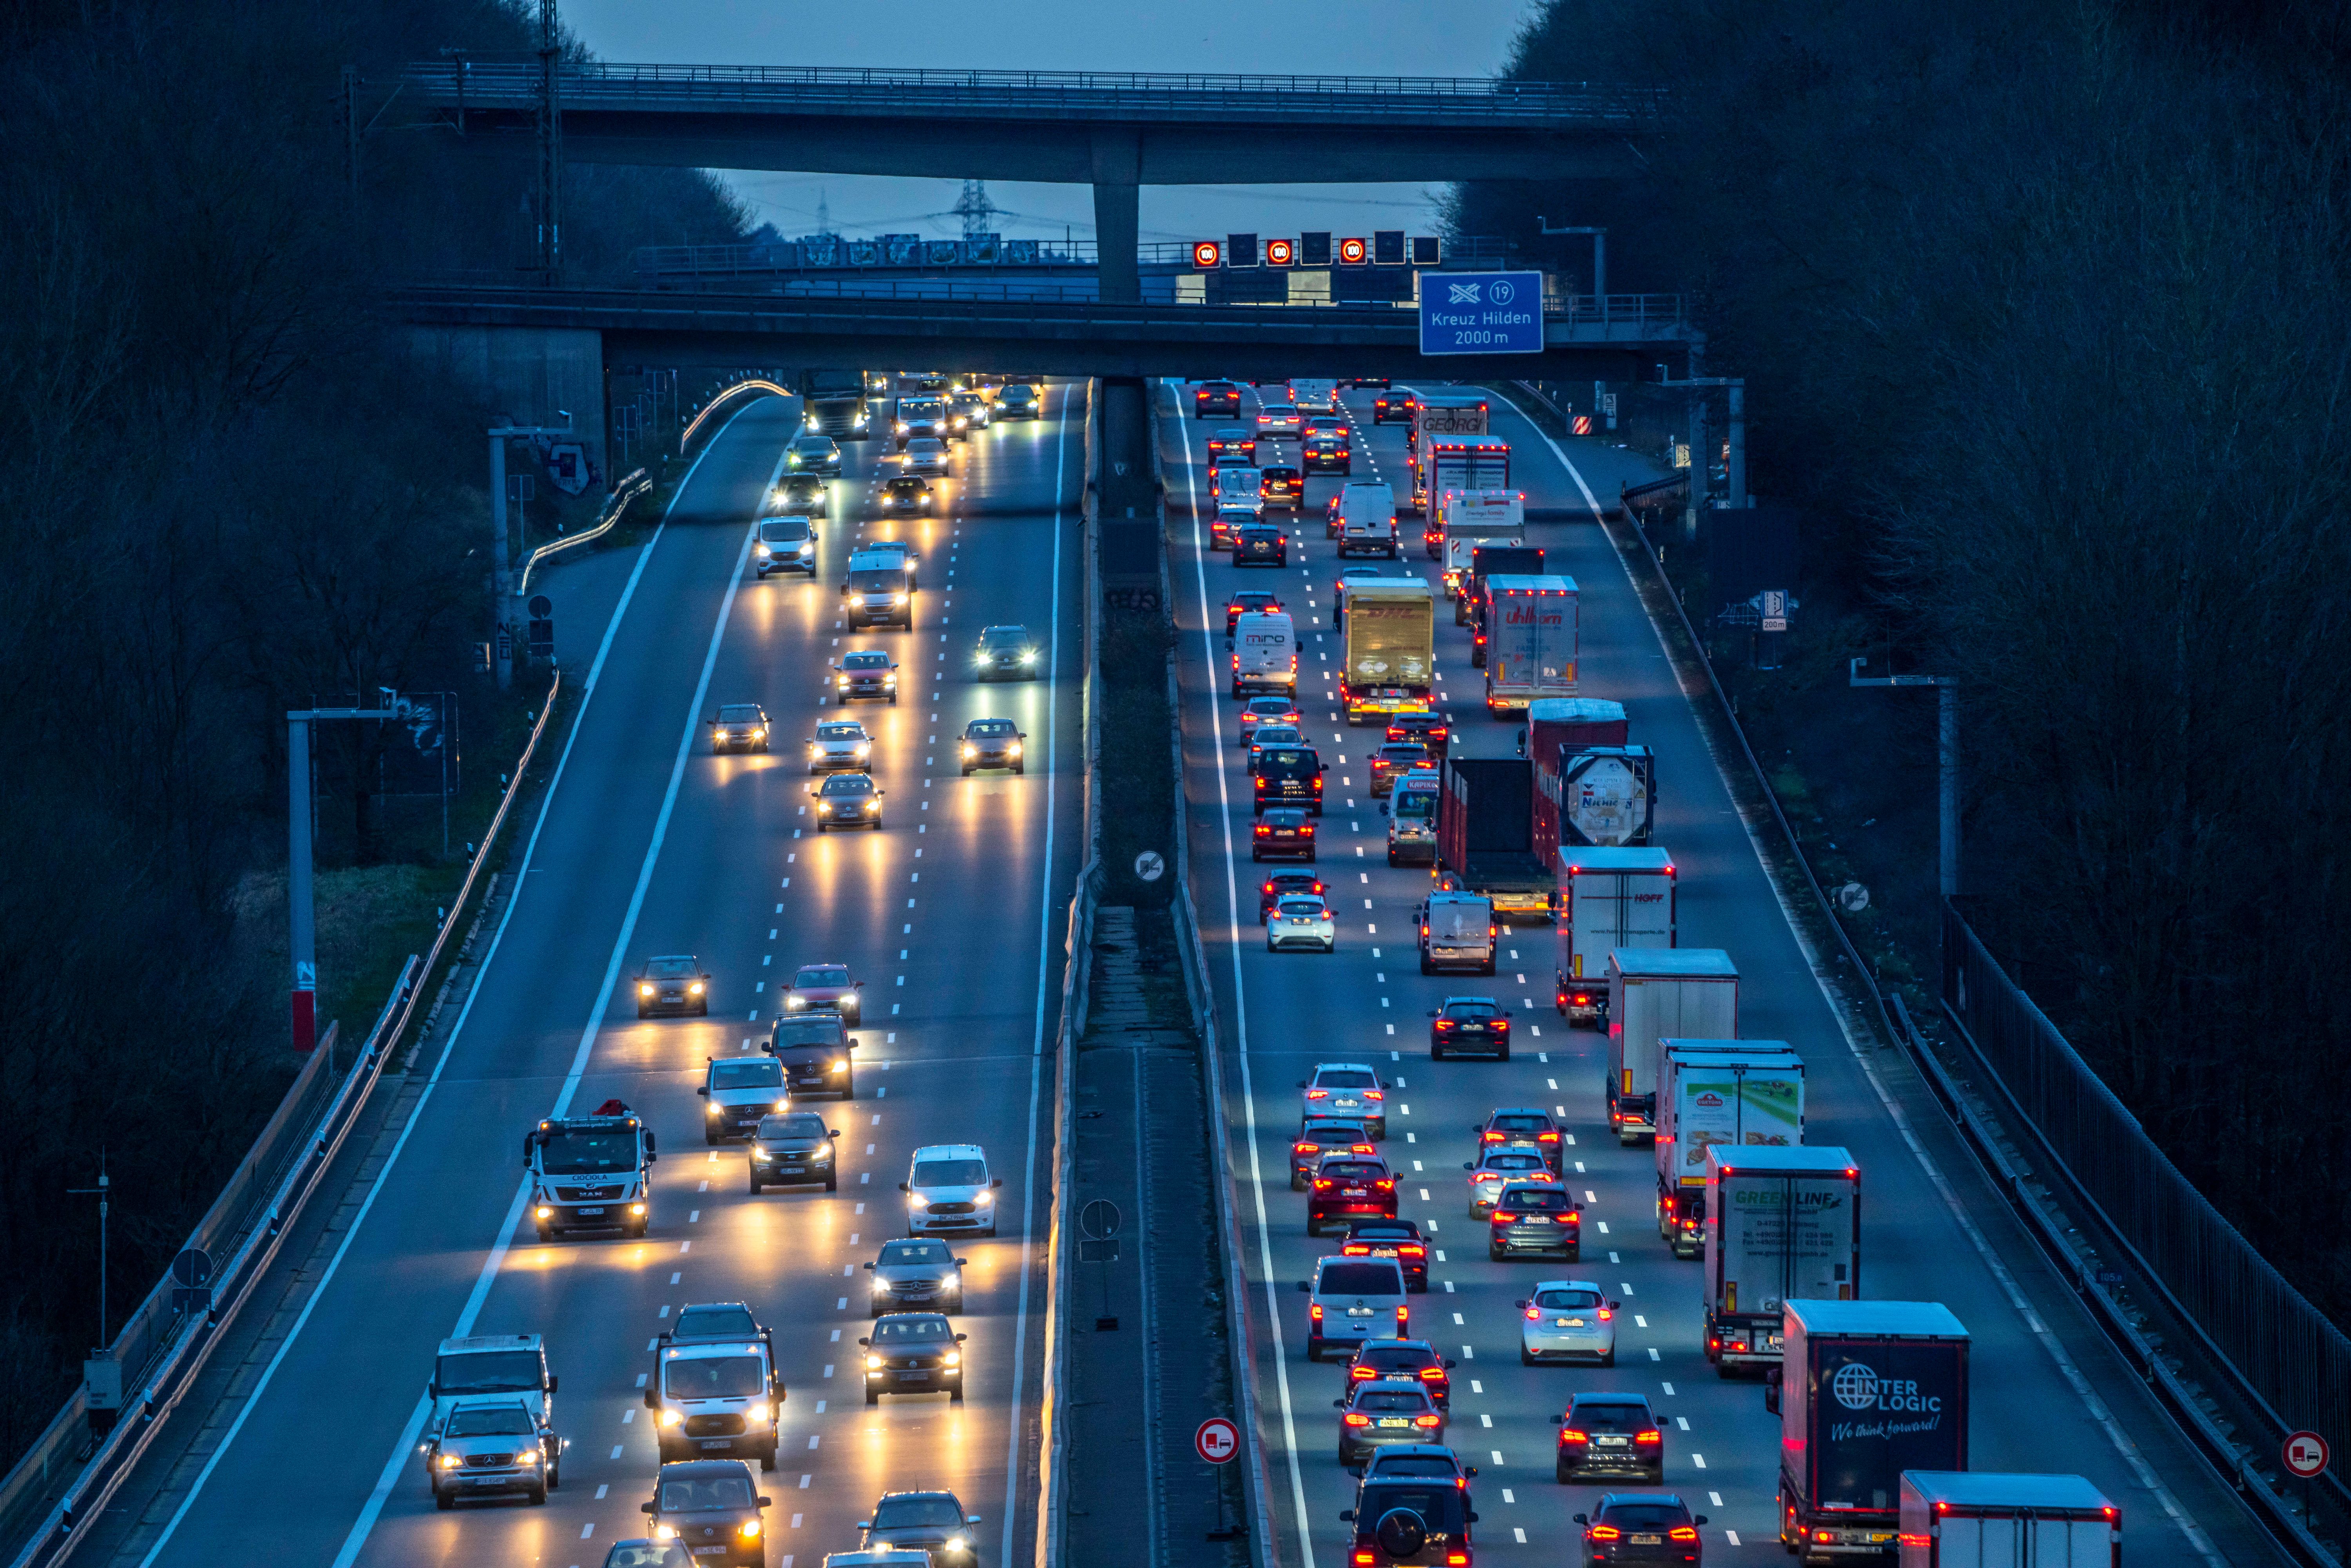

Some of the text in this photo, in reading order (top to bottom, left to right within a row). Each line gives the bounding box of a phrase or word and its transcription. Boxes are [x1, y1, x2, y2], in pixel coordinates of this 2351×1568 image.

[1201, 250, 1213, 259] 100
[1274, 248, 1286, 257] 100
[1348, 246, 1359, 255] 100
[1494, 286, 1509, 300] 19
[1432, 311, 1531, 326] Kreuz Hilden
[1455, 331, 1509, 344] 2000 m
[1423, 417, 1482, 431] GEORGI
[1634, 894, 1664, 903] HOFF
[1858, 1379, 1918, 1396] INTER
[1878, 1395, 1941, 1412] LOGIC
[1831, 1414, 1941, 1442] We think forward!
